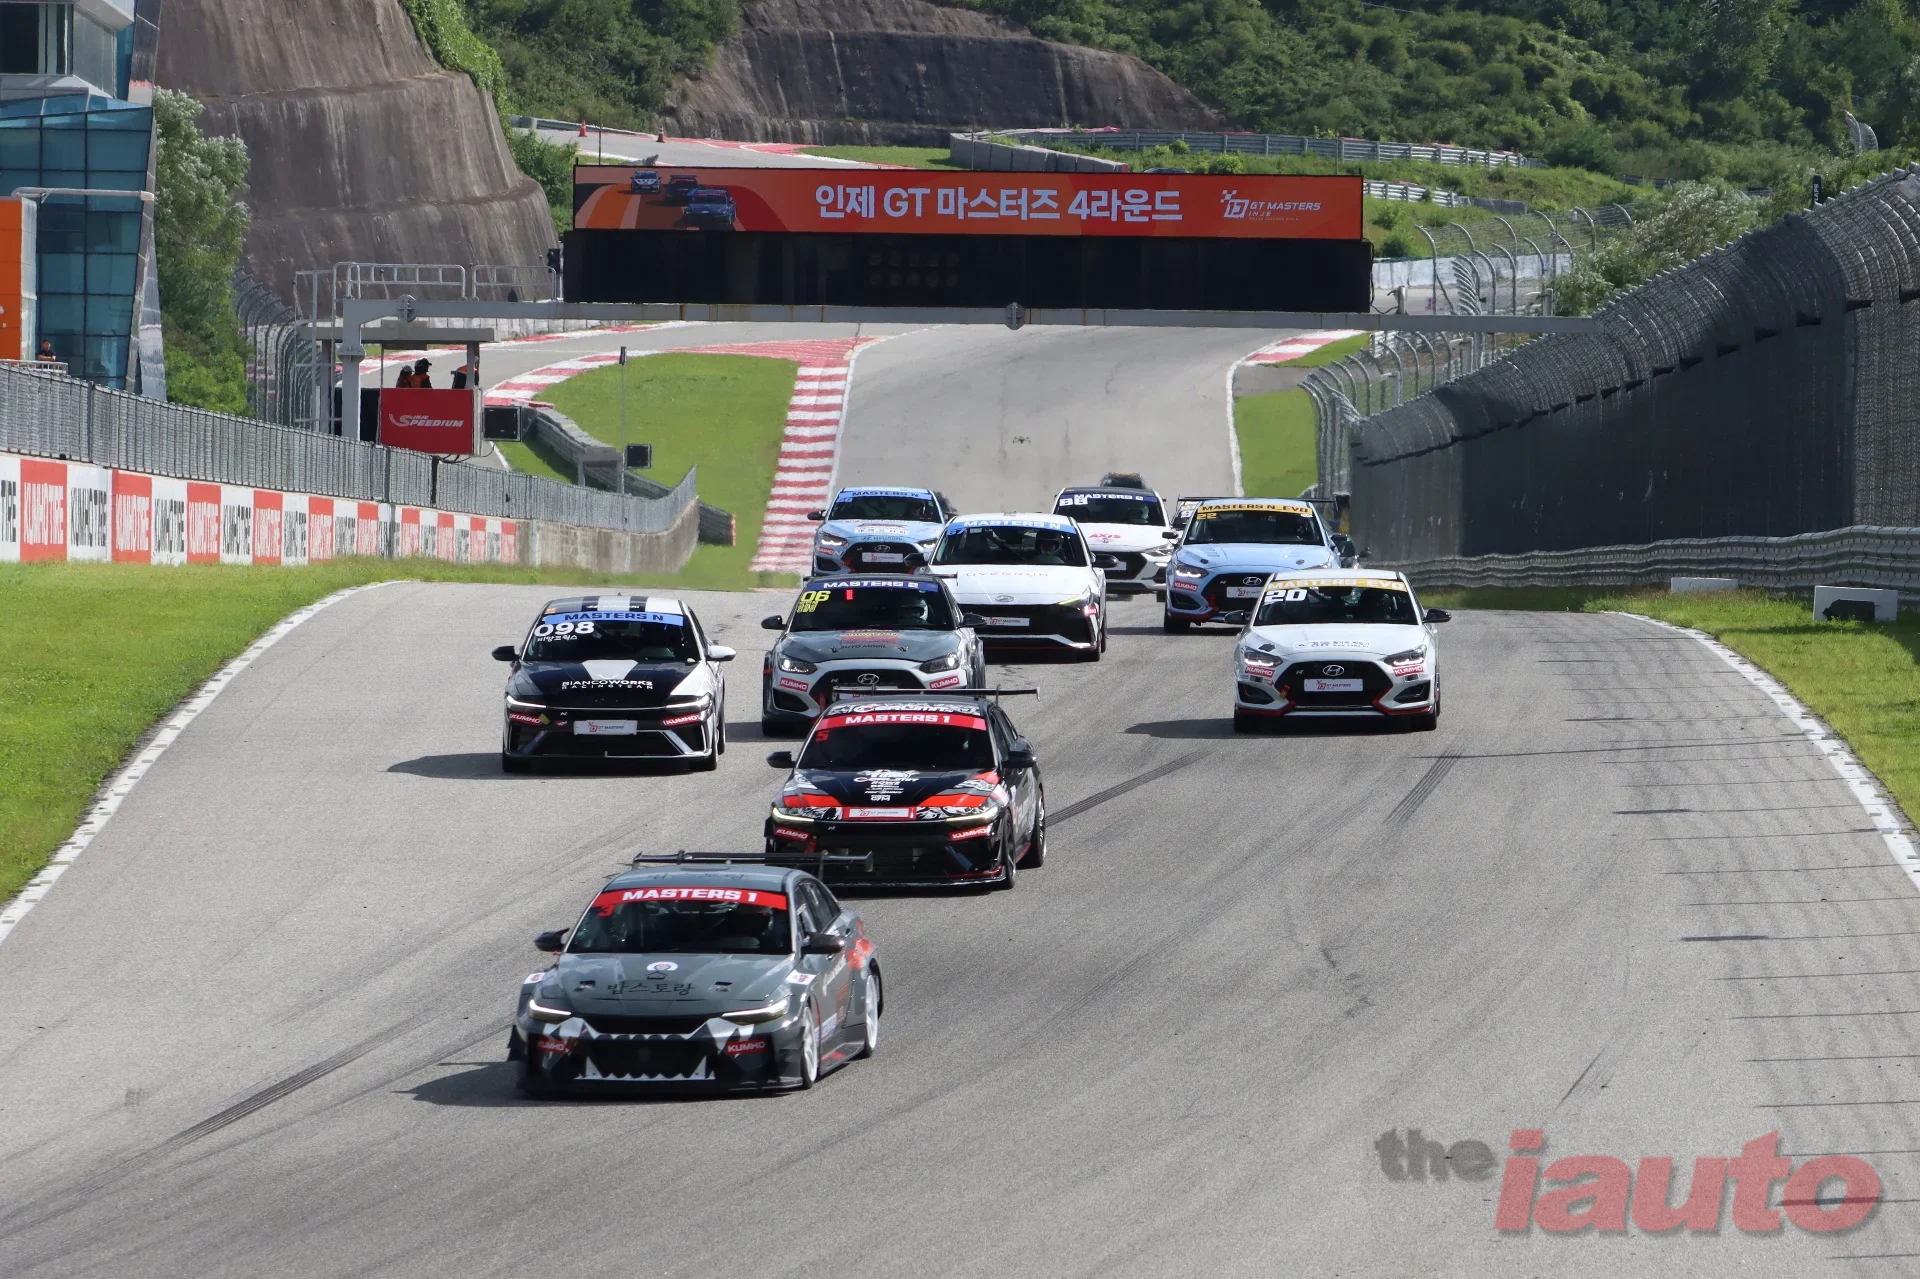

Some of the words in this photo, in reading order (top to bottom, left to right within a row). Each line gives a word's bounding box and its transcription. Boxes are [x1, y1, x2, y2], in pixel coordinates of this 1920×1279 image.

[815, 184, 875, 218] 인제
[883, 187, 931, 217] GT
[937, 186, 1060, 219] 마스터즈
[1067, 188, 1183, 222] 4라운드
[1250, 201, 1265, 210] GT
[1266, 202, 1321, 211] MASTERS
[399, 415, 464, 427] SPEEDIUM
[23, 482, 48, 546] KUMHO
[49, 484, 64, 545] TIRE
[70, 487, 93, 547] KUMHO
[93, 489, 107, 547] TIRE
[1049, 522, 1061, 530] N
[823, 580, 904, 589] MASTERS
[1174, 581, 1198, 591] KUMHO
[800, 590, 832, 602] 06
[1264, 589, 1308, 603] 20
[564, 612, 648, 621] MASTERS
[652, 614, 664, 622] N
[533, 621, 595, 637] 098
[1245, 666, 1273, 677] KUMHO
[1395, 665, 1423, 675] KUMHO
[780, 677, 808, 691] KUMHO
[931, 677, 958, 690] KUMHO
[845, 713, 938, 725] MASTERS
[942, 715, 950, 723] 1
[815, 730, 830, 742] 5
[776, 828, 809, 840] KUMHO
[952, 828, 987, 839] KUMHO
[622, 887, 742, 901] MASTERS
[748, 892, 758, 903] 1
[607, 980, 696, 996] 밥스토랑
[727, 1041, 766, 1053] KUMHO
